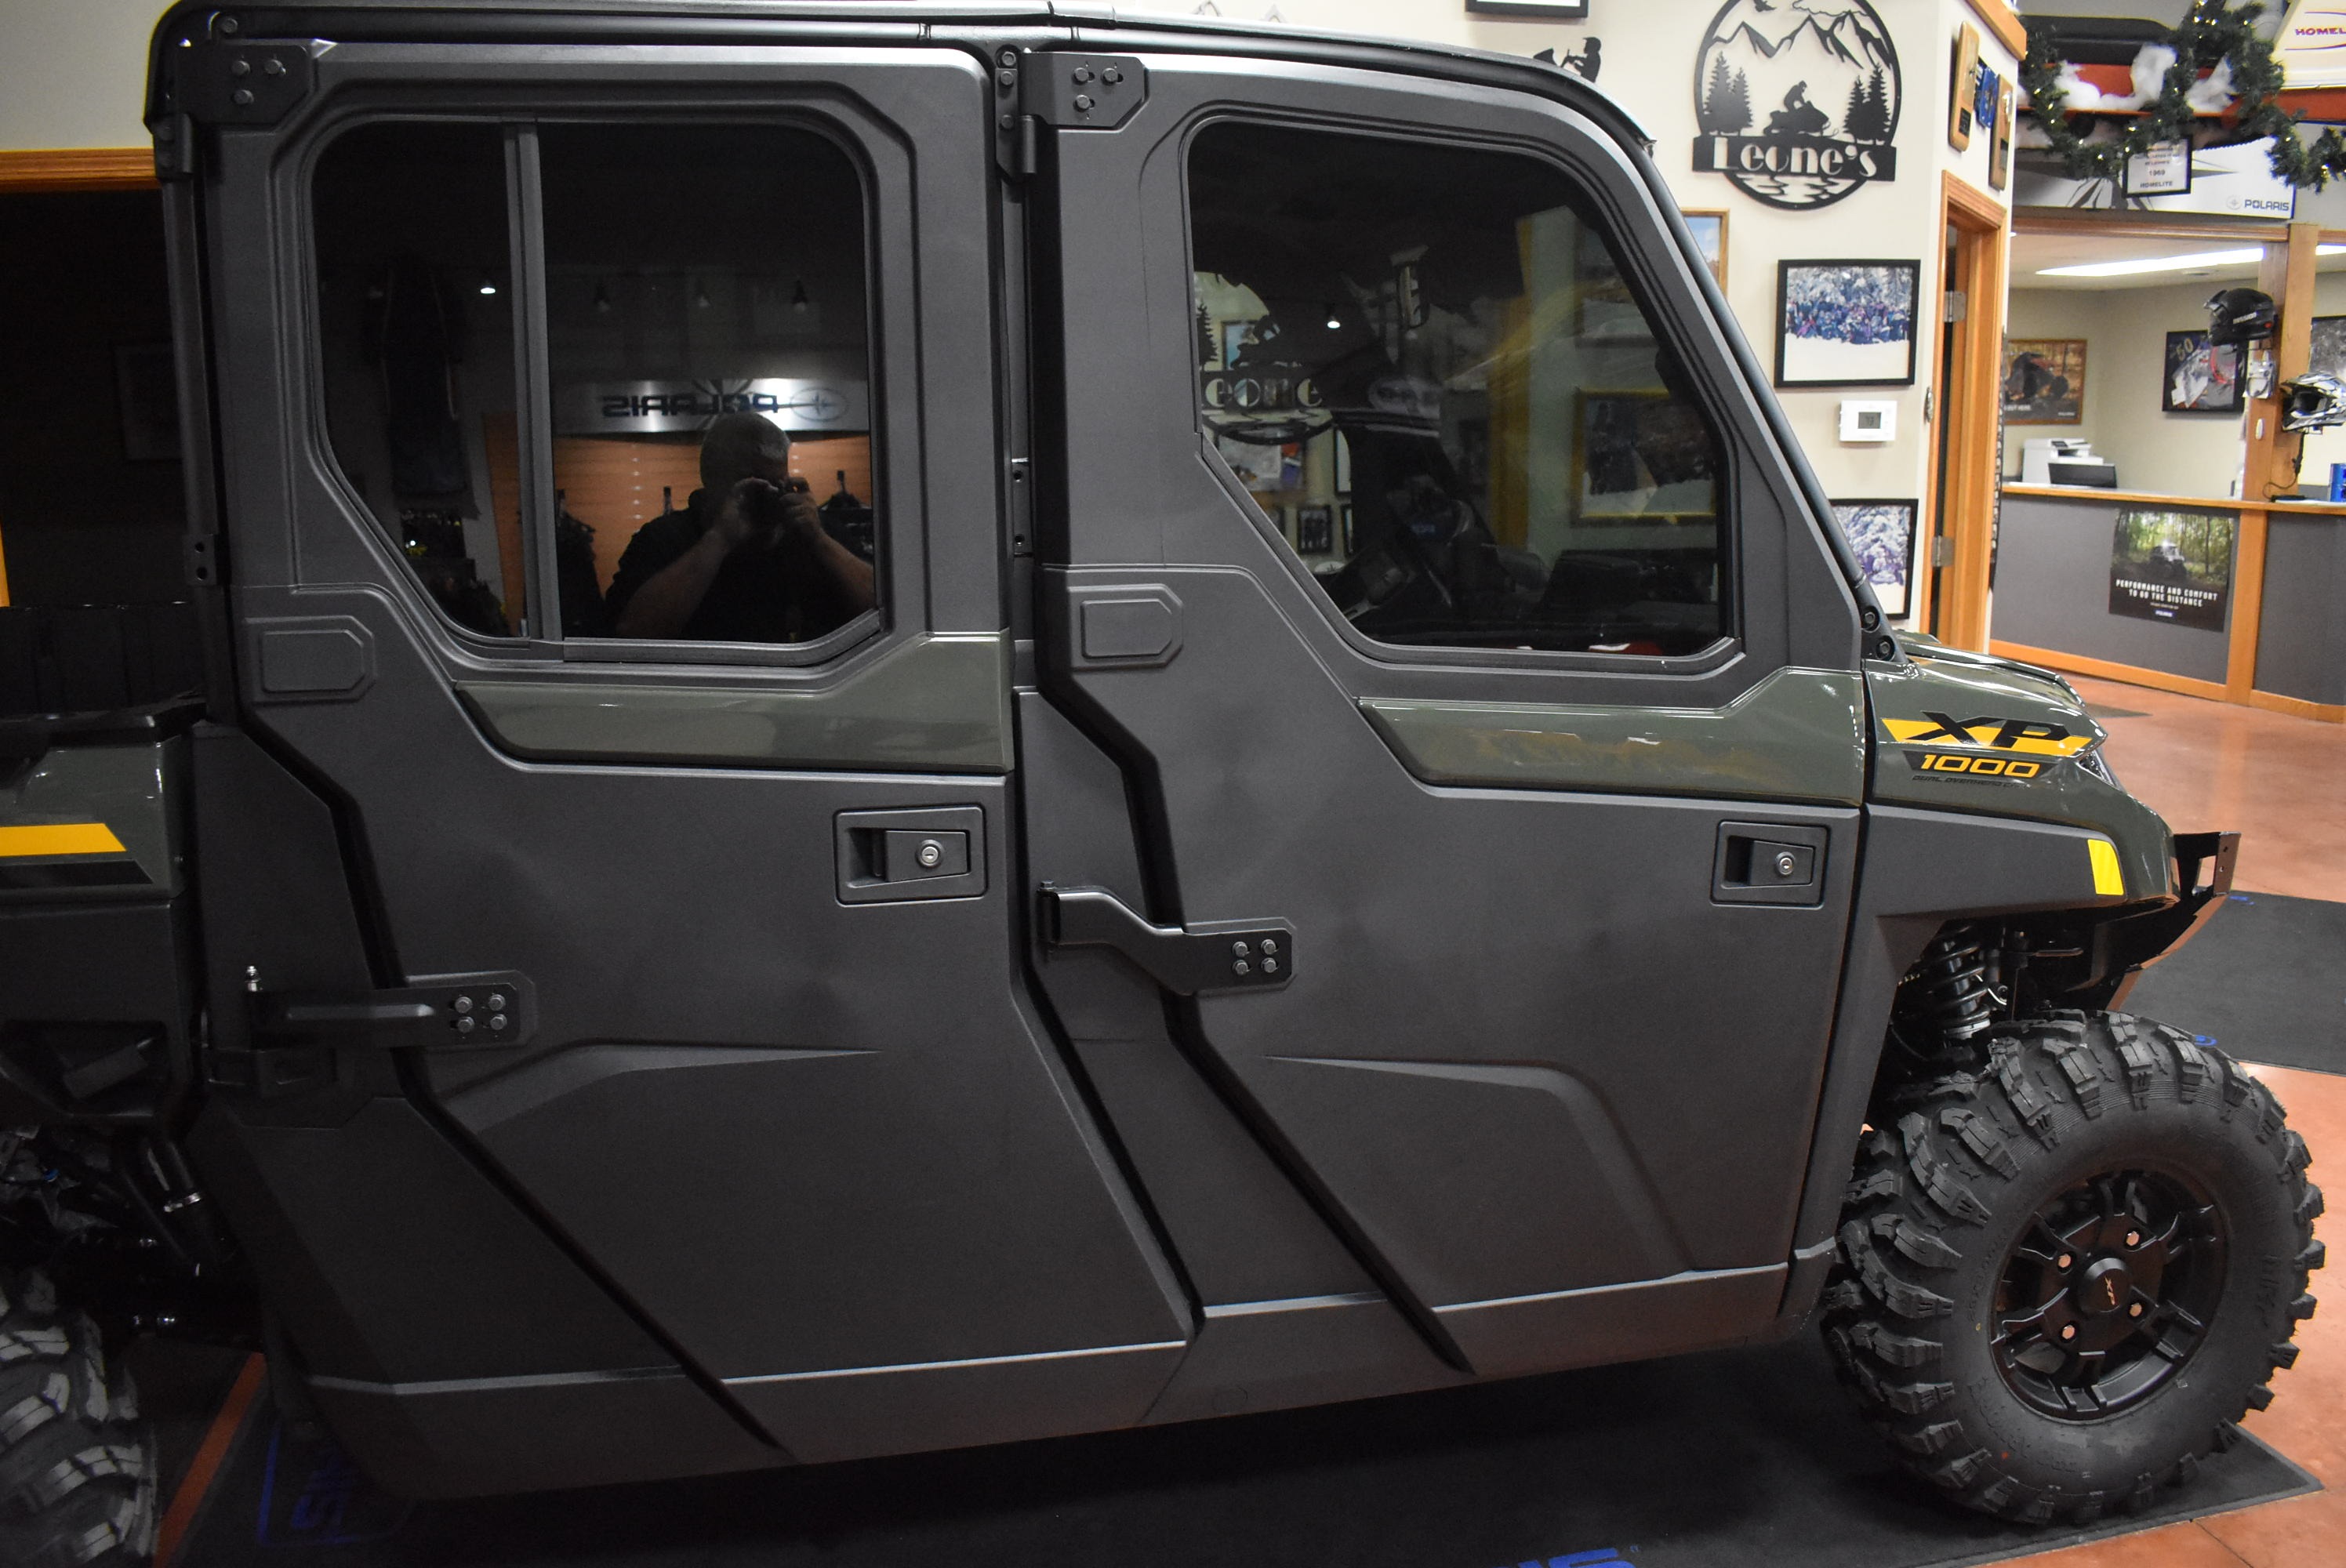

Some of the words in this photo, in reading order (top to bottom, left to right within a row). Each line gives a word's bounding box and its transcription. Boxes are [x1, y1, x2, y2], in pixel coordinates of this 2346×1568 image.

[1713, 136, 1877, 177] Leone's
[2245, 199, 2290, 211] POLARIS
[2115, 579, 2166, 593] PERFORMANCE
[2166, 586, 2182, 596] AND
[2184, 589, 2218, 601] COMFORT
[2129, 589, 2138, 597] TO
[2151, 592, 2165, 601] THE
[2166, 594, 2203, 608] DISTANCE
[1903, 711, 2072, 749] XP
[1921, 754, 2040, 779] 1000
[1945, 777, 2003, 787] OVERHEAD
